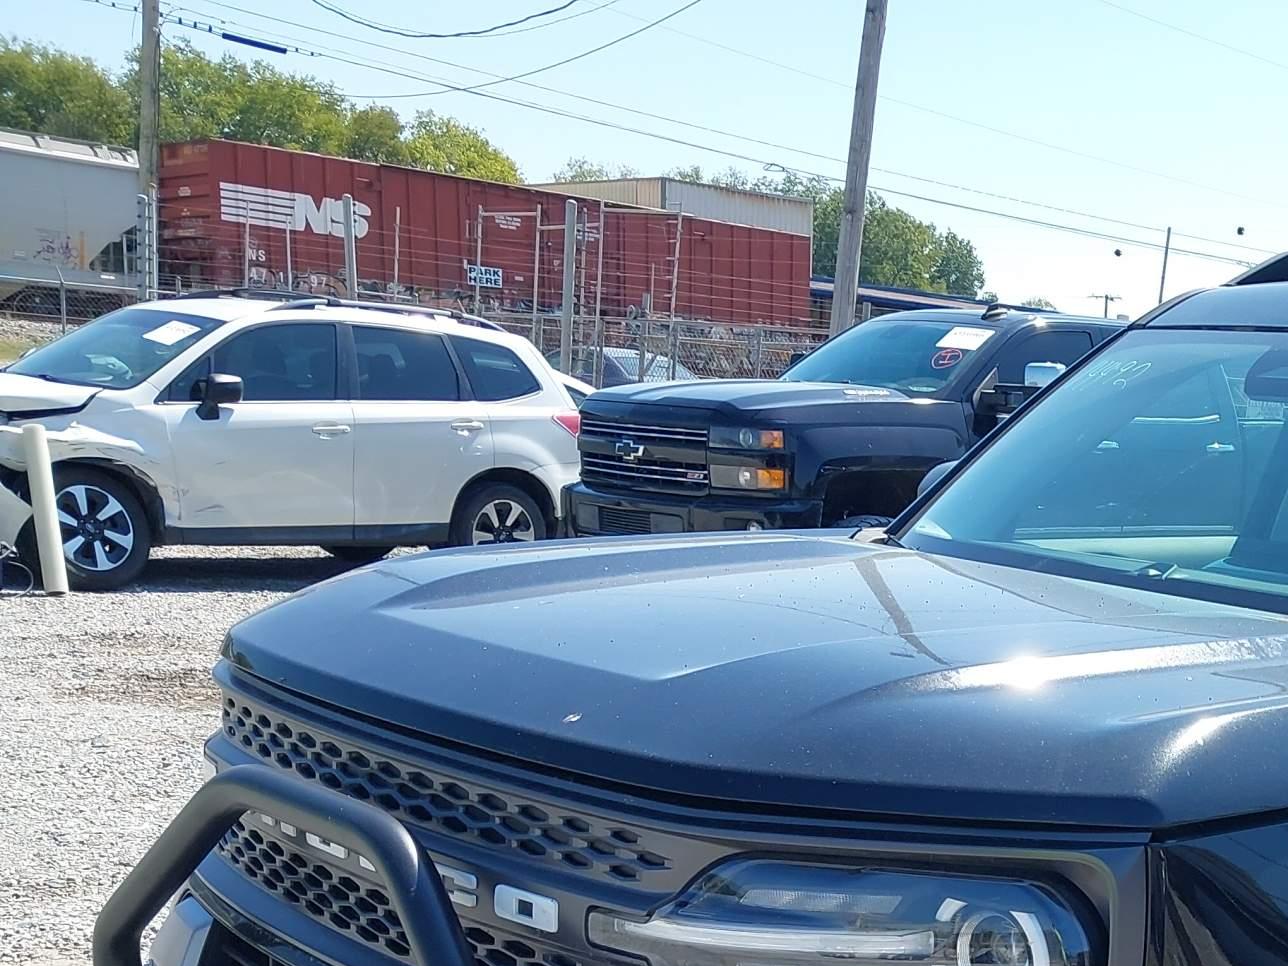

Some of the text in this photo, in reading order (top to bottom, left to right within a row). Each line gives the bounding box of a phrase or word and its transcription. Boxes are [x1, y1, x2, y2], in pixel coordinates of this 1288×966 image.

[295, 192, 372, 239] NS
[248, 248, 266, 262] NS
[468, 266, 501, 278] PARK
[468, 276, 501, 287] HERE
